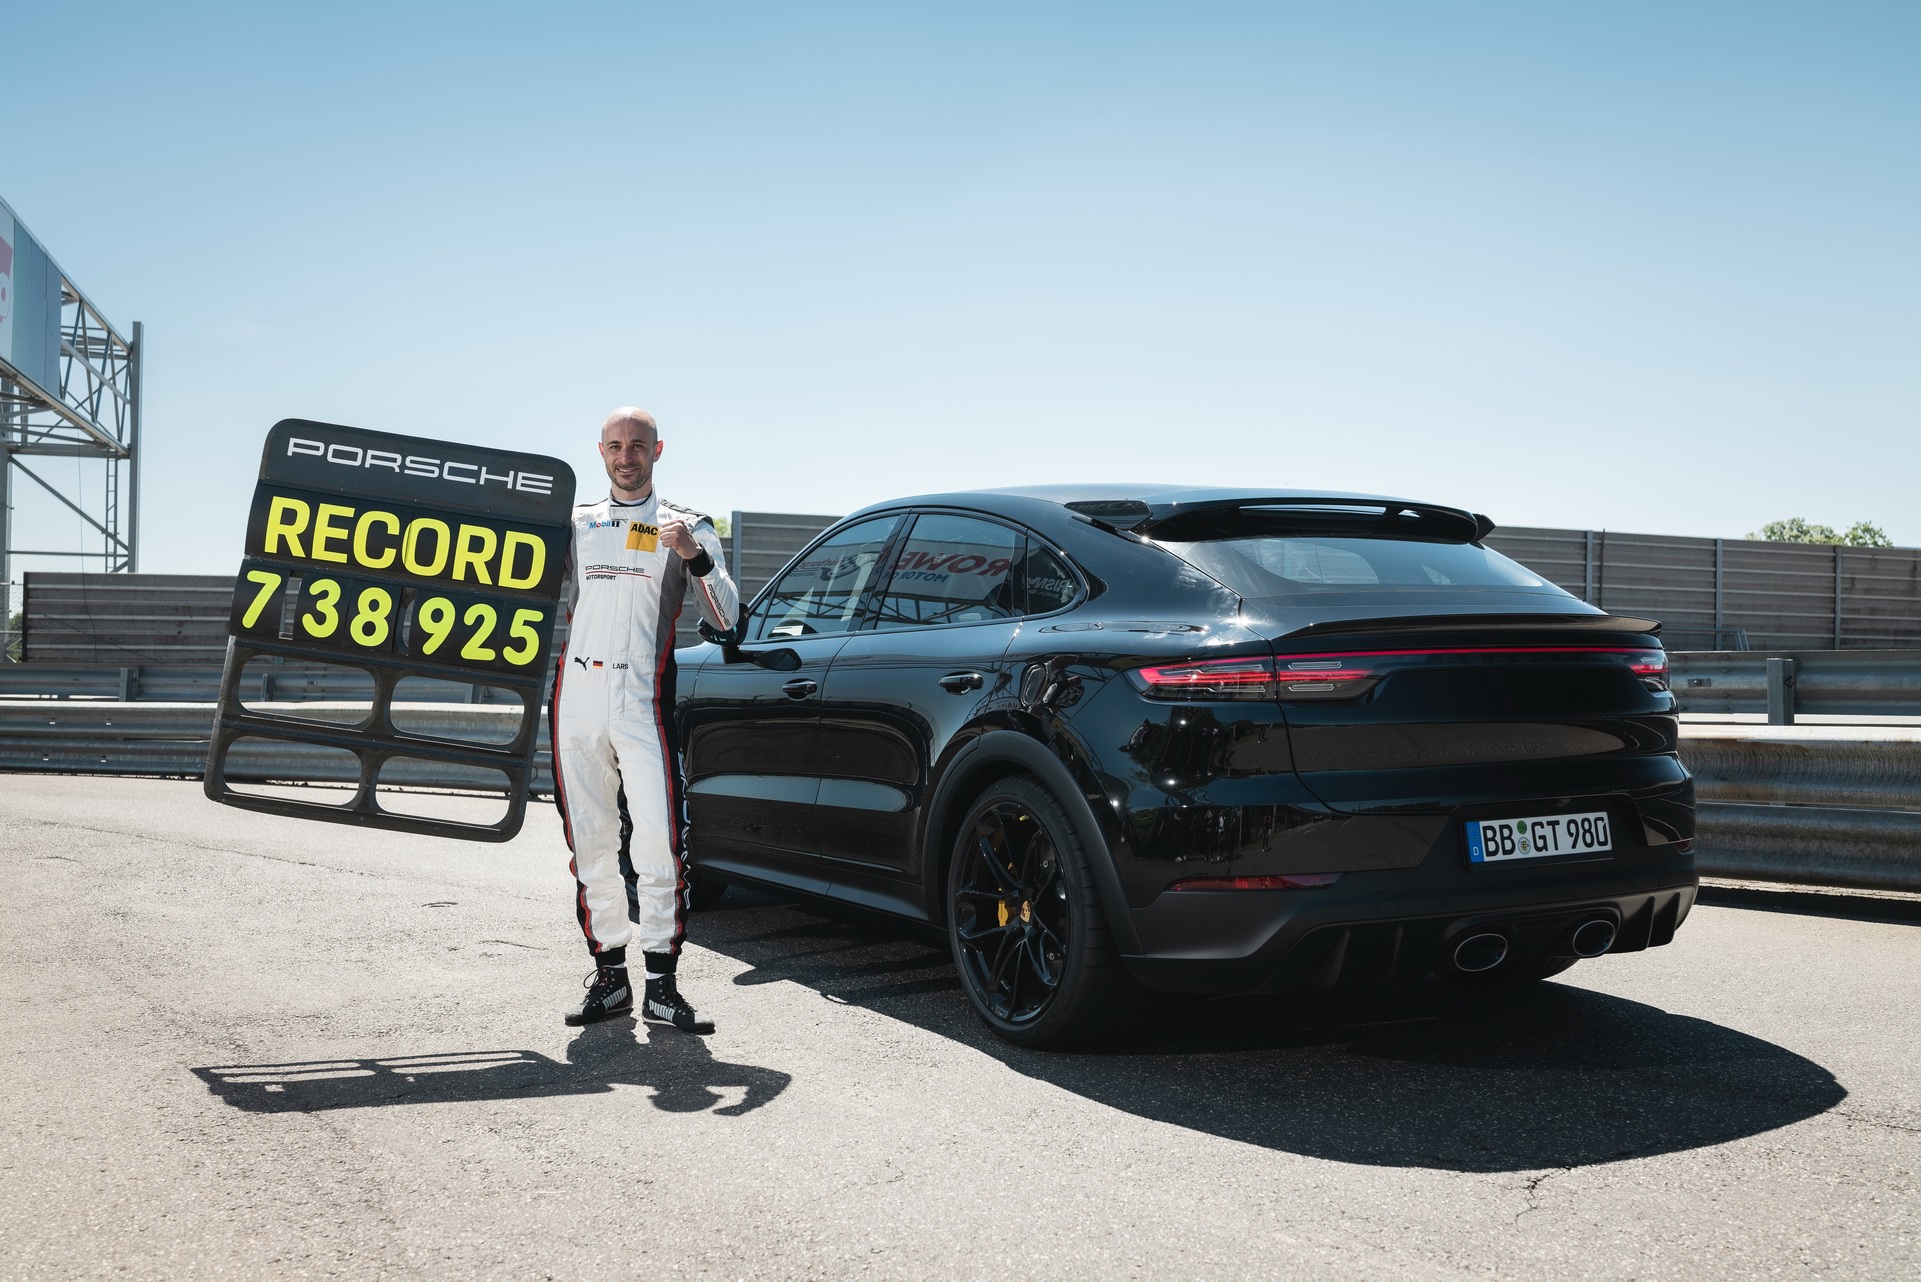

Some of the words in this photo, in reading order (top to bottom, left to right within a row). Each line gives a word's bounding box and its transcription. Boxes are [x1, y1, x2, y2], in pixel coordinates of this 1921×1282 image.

[286, 437, 554, 495] PORSCHE
[589, 520, 611, 529] Mobil
[631, 523, 659, 536] ADAC
[264, 497, 546, 590] RECORD
[585, 564, 645, 573] PORSCHE
[241, 571, 280, 629] 7
[303, 579, 391, 646] 38
[419, 596, 543, 665] 925
[707, 583, 732, 628] PORSCHE
[612, 662, 629, 670] LARS
[1473, 846, 1480, 856] D
[1482, 825, 1516, 858] BB
[1531, 820, 1561, 853] GT
[1567, 816, 1609, 850] 980
[602, 986, 628, 1011] PUMA
[648, 999, 675, 1022] PUMA
